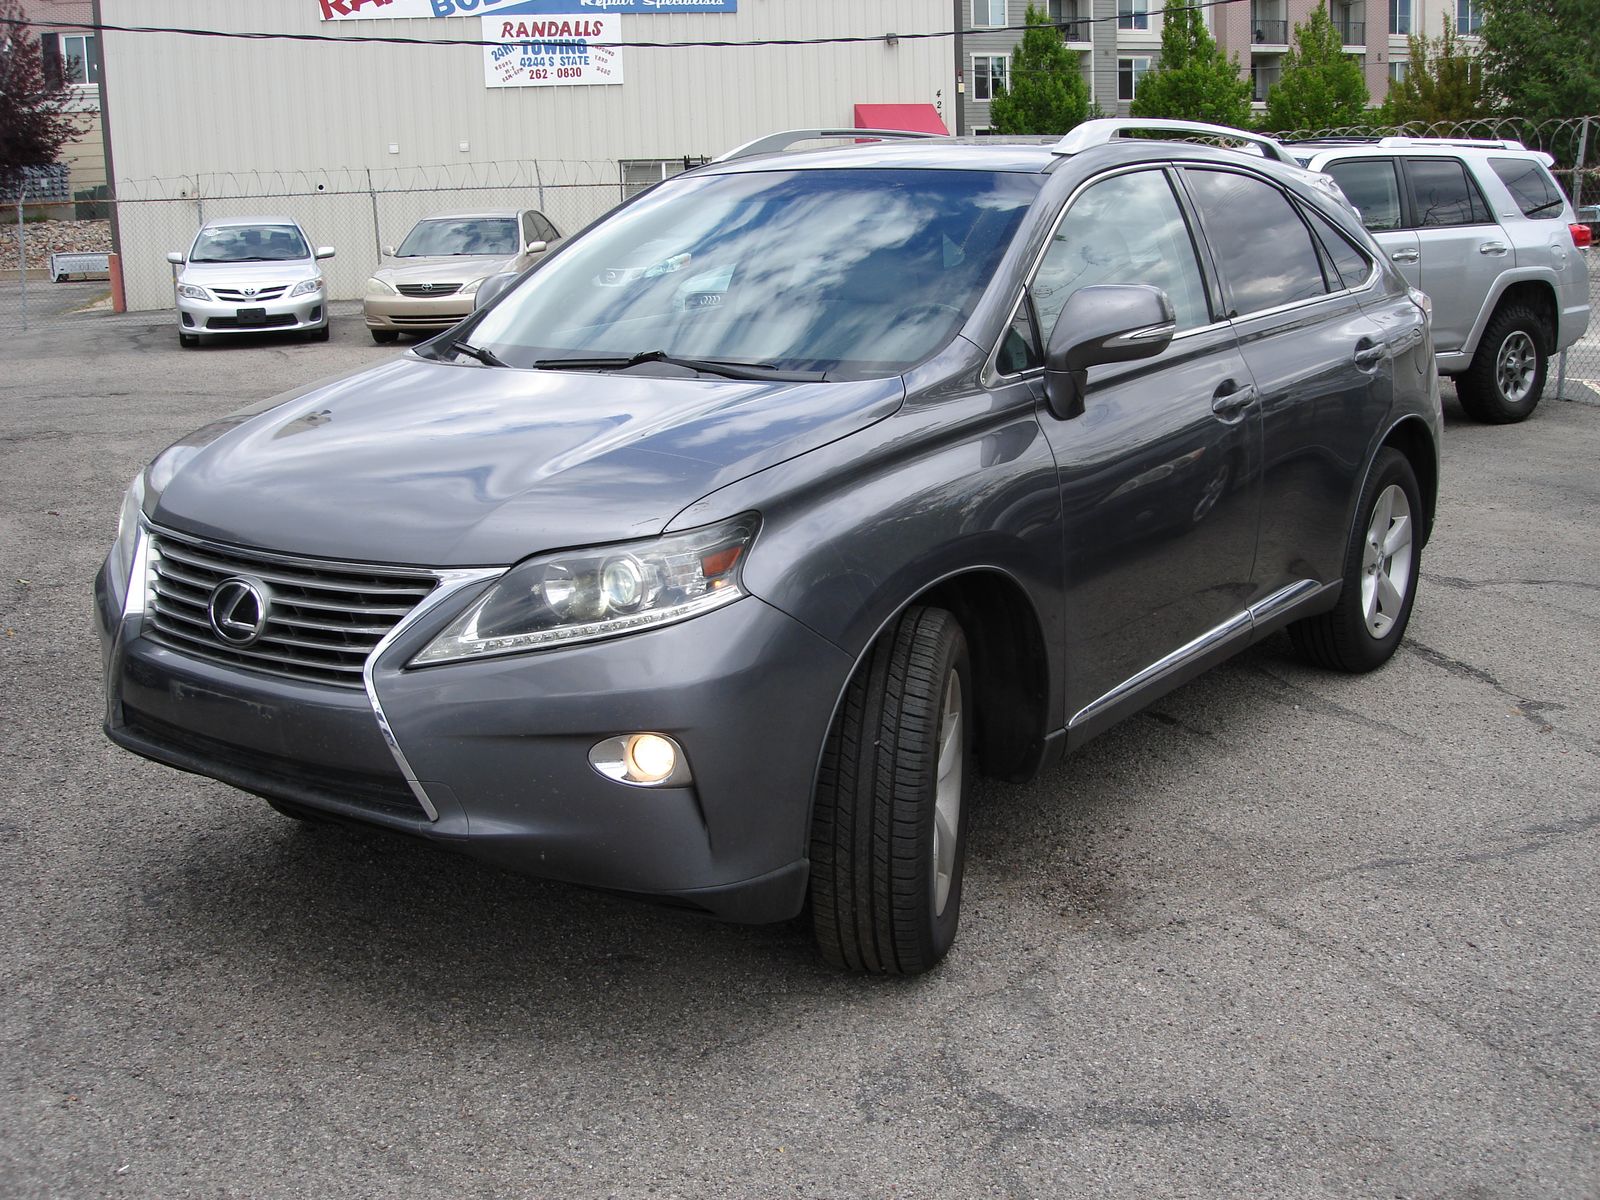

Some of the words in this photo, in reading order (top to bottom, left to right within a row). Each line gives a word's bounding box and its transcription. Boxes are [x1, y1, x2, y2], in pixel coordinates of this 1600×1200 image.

[501, 21, 604, 38] RANDALLS
[519, 38, 588, 56] TOWING
[519, 57, 546, 68] 4244
[548, 56, 555, 67] S
[559, 55, 590, 66] STATE
